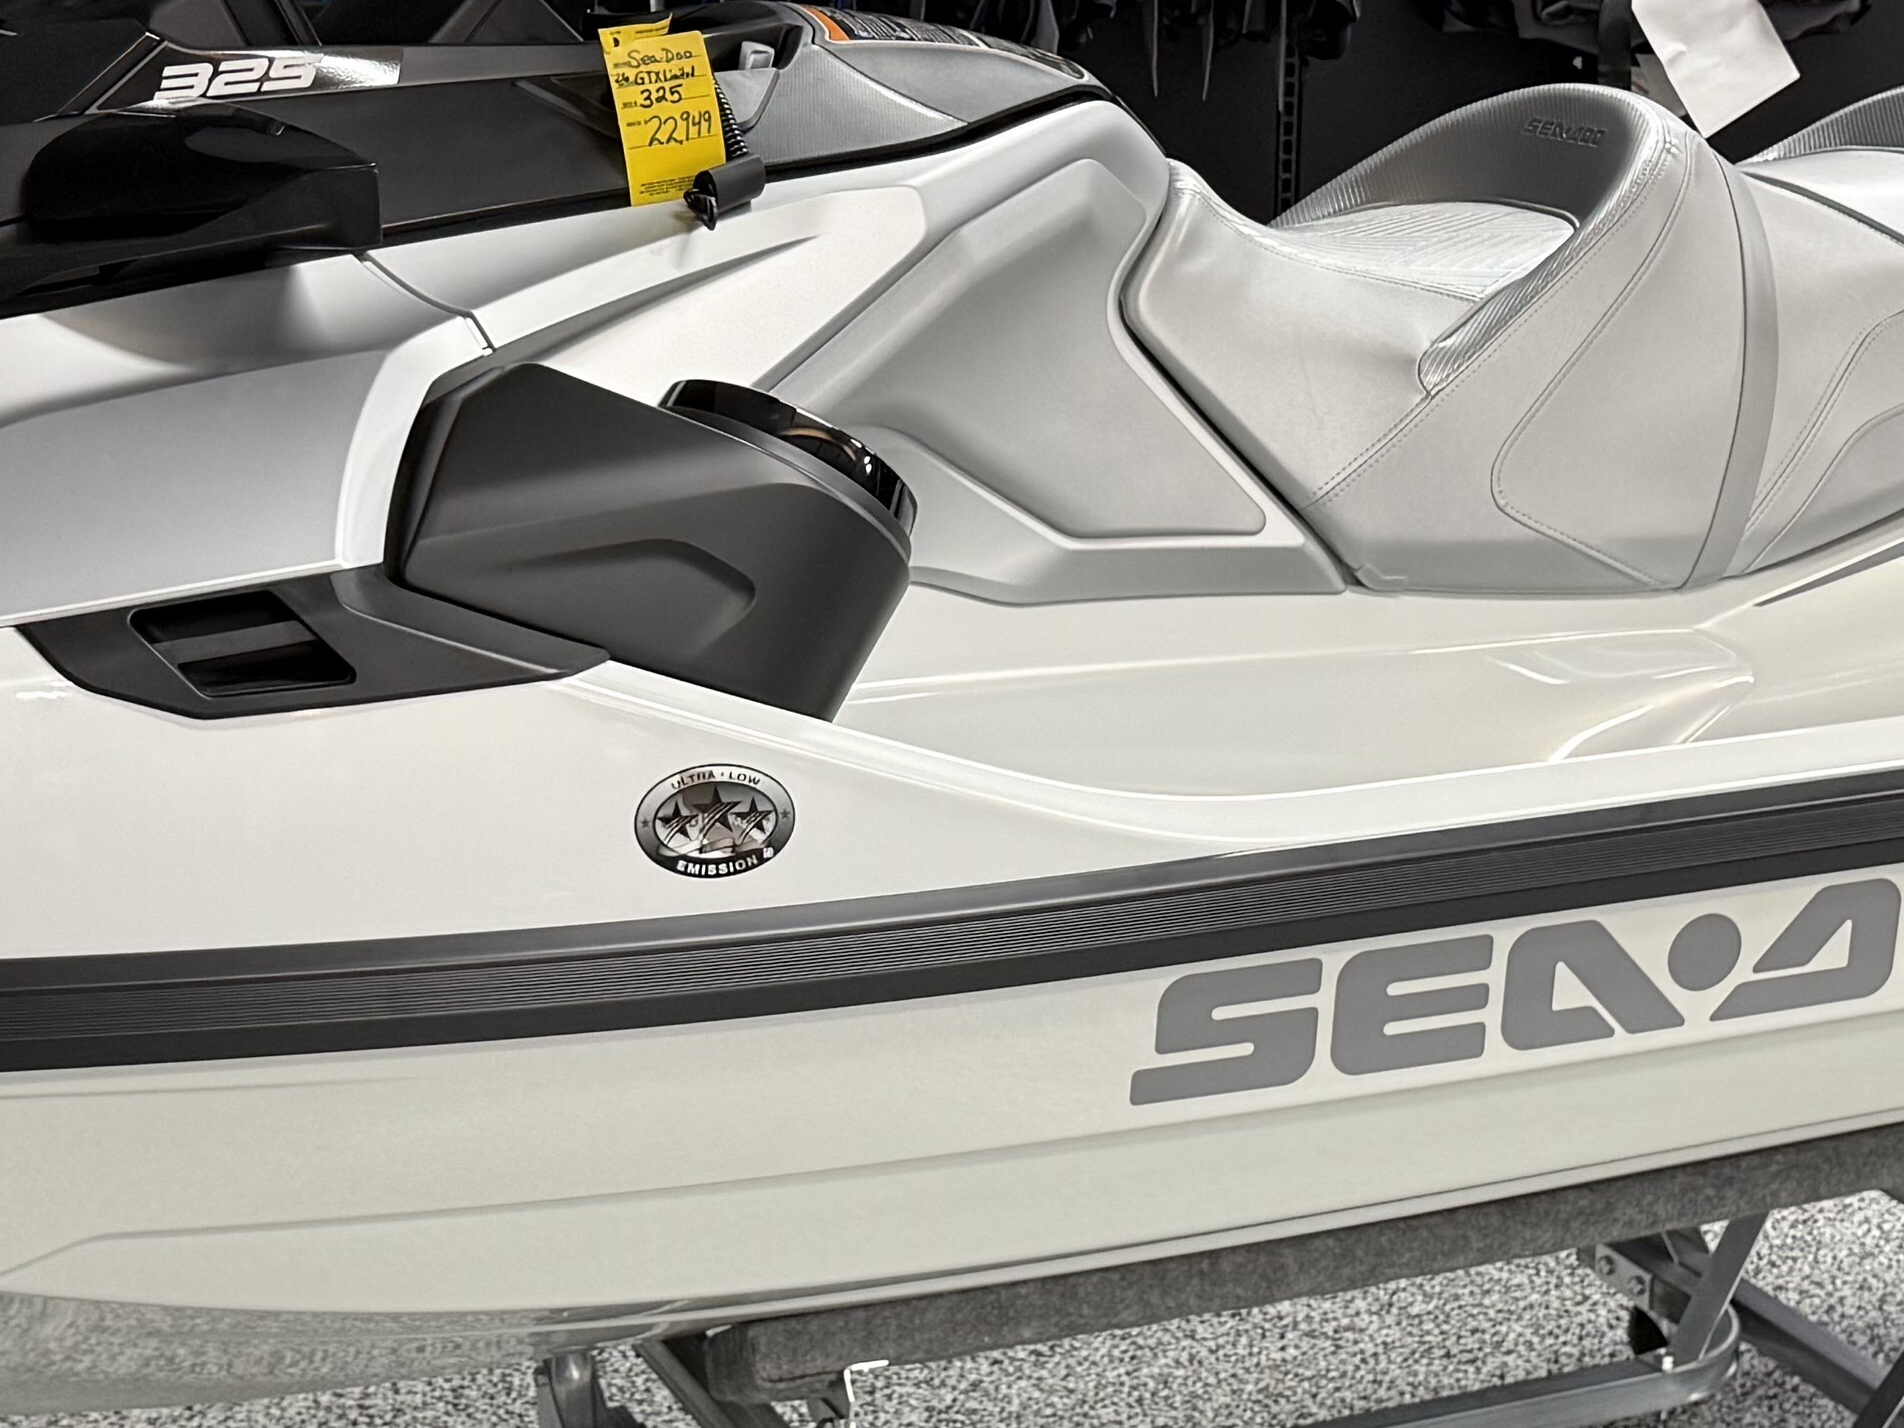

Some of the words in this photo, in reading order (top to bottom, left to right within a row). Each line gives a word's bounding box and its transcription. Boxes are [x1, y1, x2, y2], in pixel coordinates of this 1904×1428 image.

[152, 56, 317, 102] 325
[639, 83, 684, 109] 325
[729, 771, 761, 787] LOW
[676, 855, 759, 875] EMISSION
